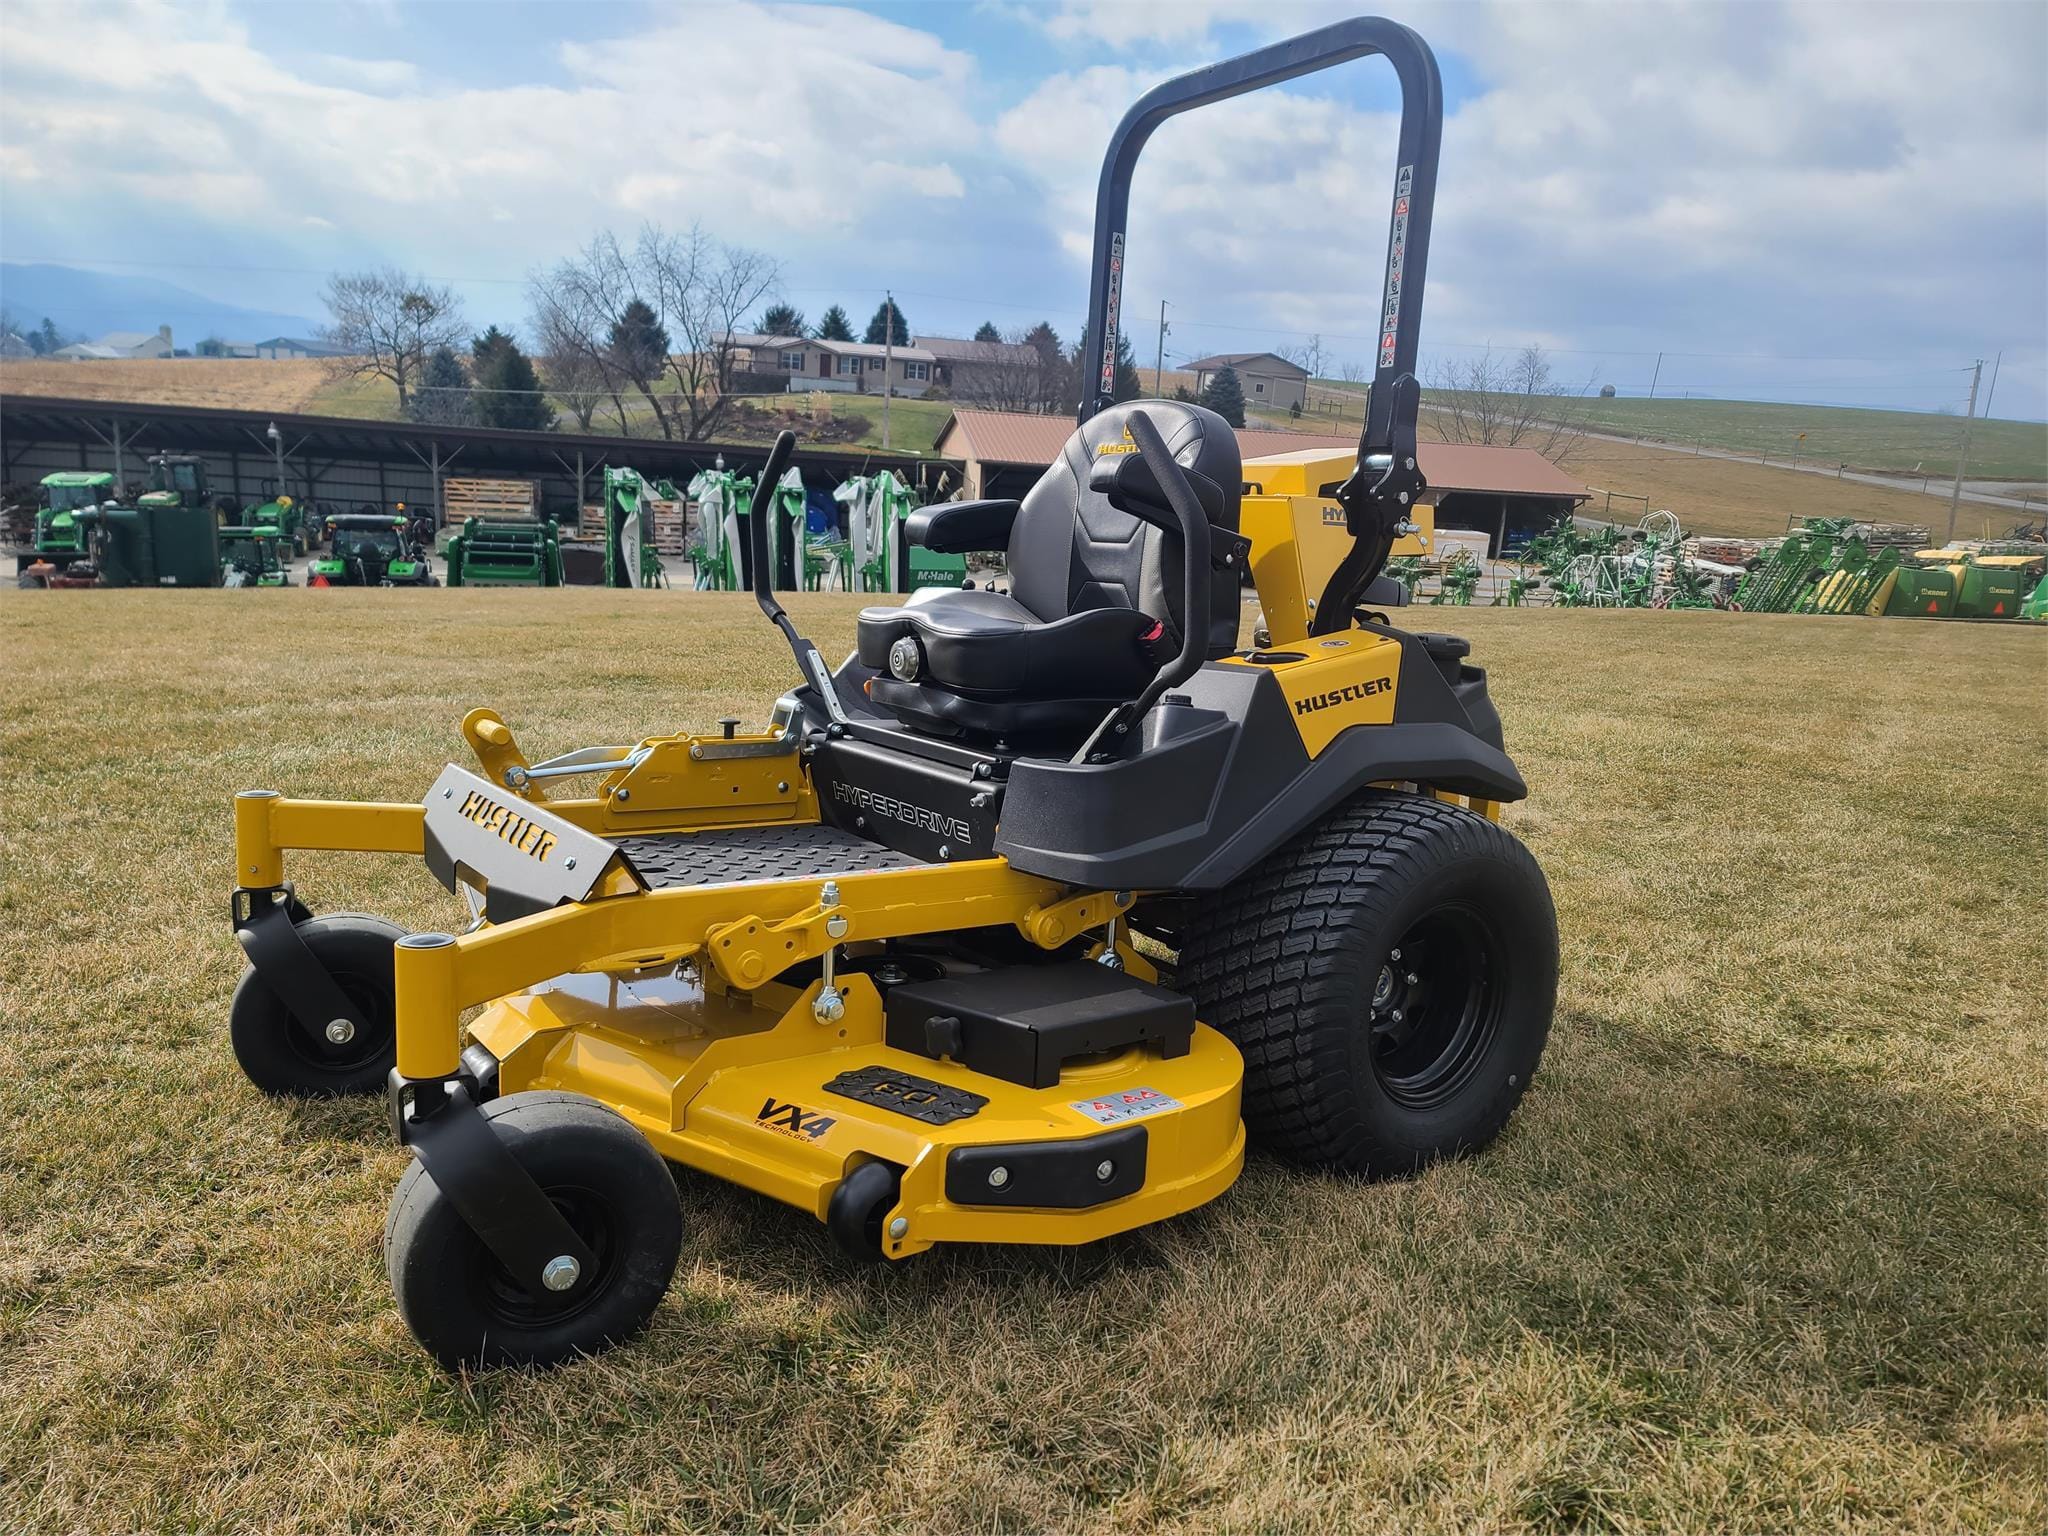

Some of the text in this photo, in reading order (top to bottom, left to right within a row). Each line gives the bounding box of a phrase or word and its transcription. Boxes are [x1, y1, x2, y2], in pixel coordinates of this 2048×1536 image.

[1295, 677, 1392, 715] HUSTLER
[458, 790, 559, 863] HUSTLER
[833, 781, 971, 844] HYPERDRIVE
[754, 1120, 814, 1143] TECHNOLOGY
[757, 1097, 837, 1138] VX4
